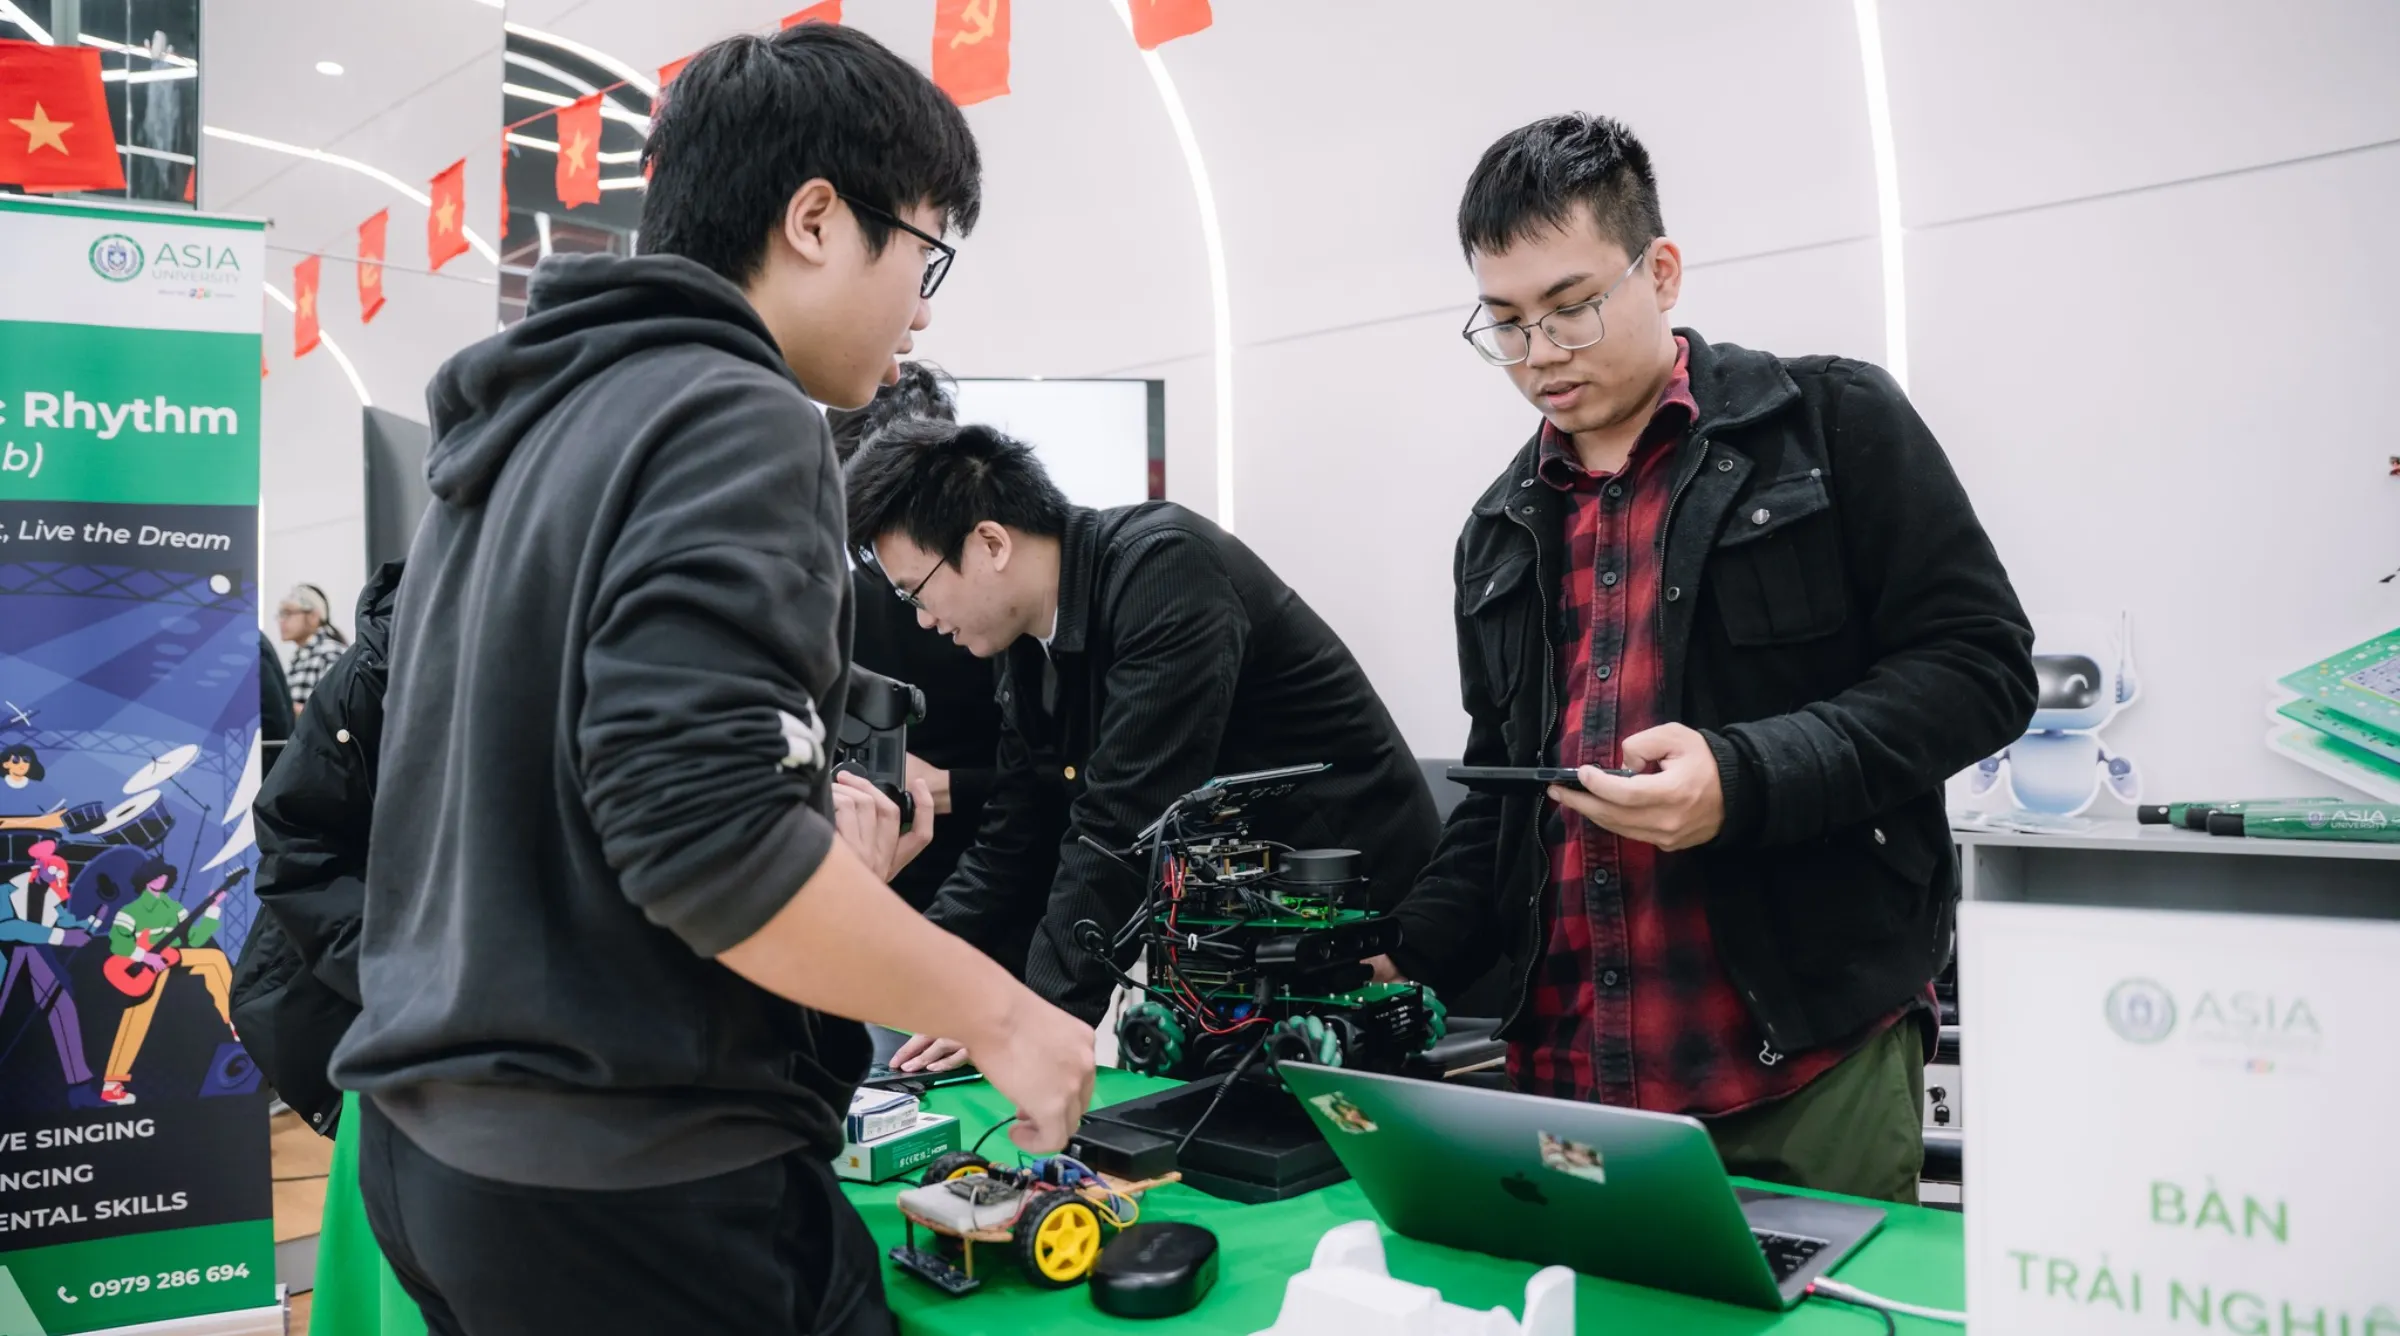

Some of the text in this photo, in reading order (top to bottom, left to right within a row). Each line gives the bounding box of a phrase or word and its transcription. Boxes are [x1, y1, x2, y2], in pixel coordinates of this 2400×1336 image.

[154, 242, 240, 271] ASIA
[152, 269, 238, 284] UNIVERSITY
[24, 391, 238, 440] Rhythm
[18, 519, 75, 541] Live
[83, 522, 131, 544] the
[138, 525, 231, 550] Dream
[2331, 821, 2387, 830] UNIVERSITY
[2332, 810, 2387, 825] ASIA
[2190, 990, 2322, 1034] ASIA
[35, 1118, 155, 1149] SINGING
[0, 1164, 94, 1192] NCING
[94, 1191, 189, 1220] SKILLS
[89, 1262, 250, 1299] 0979 286 694
